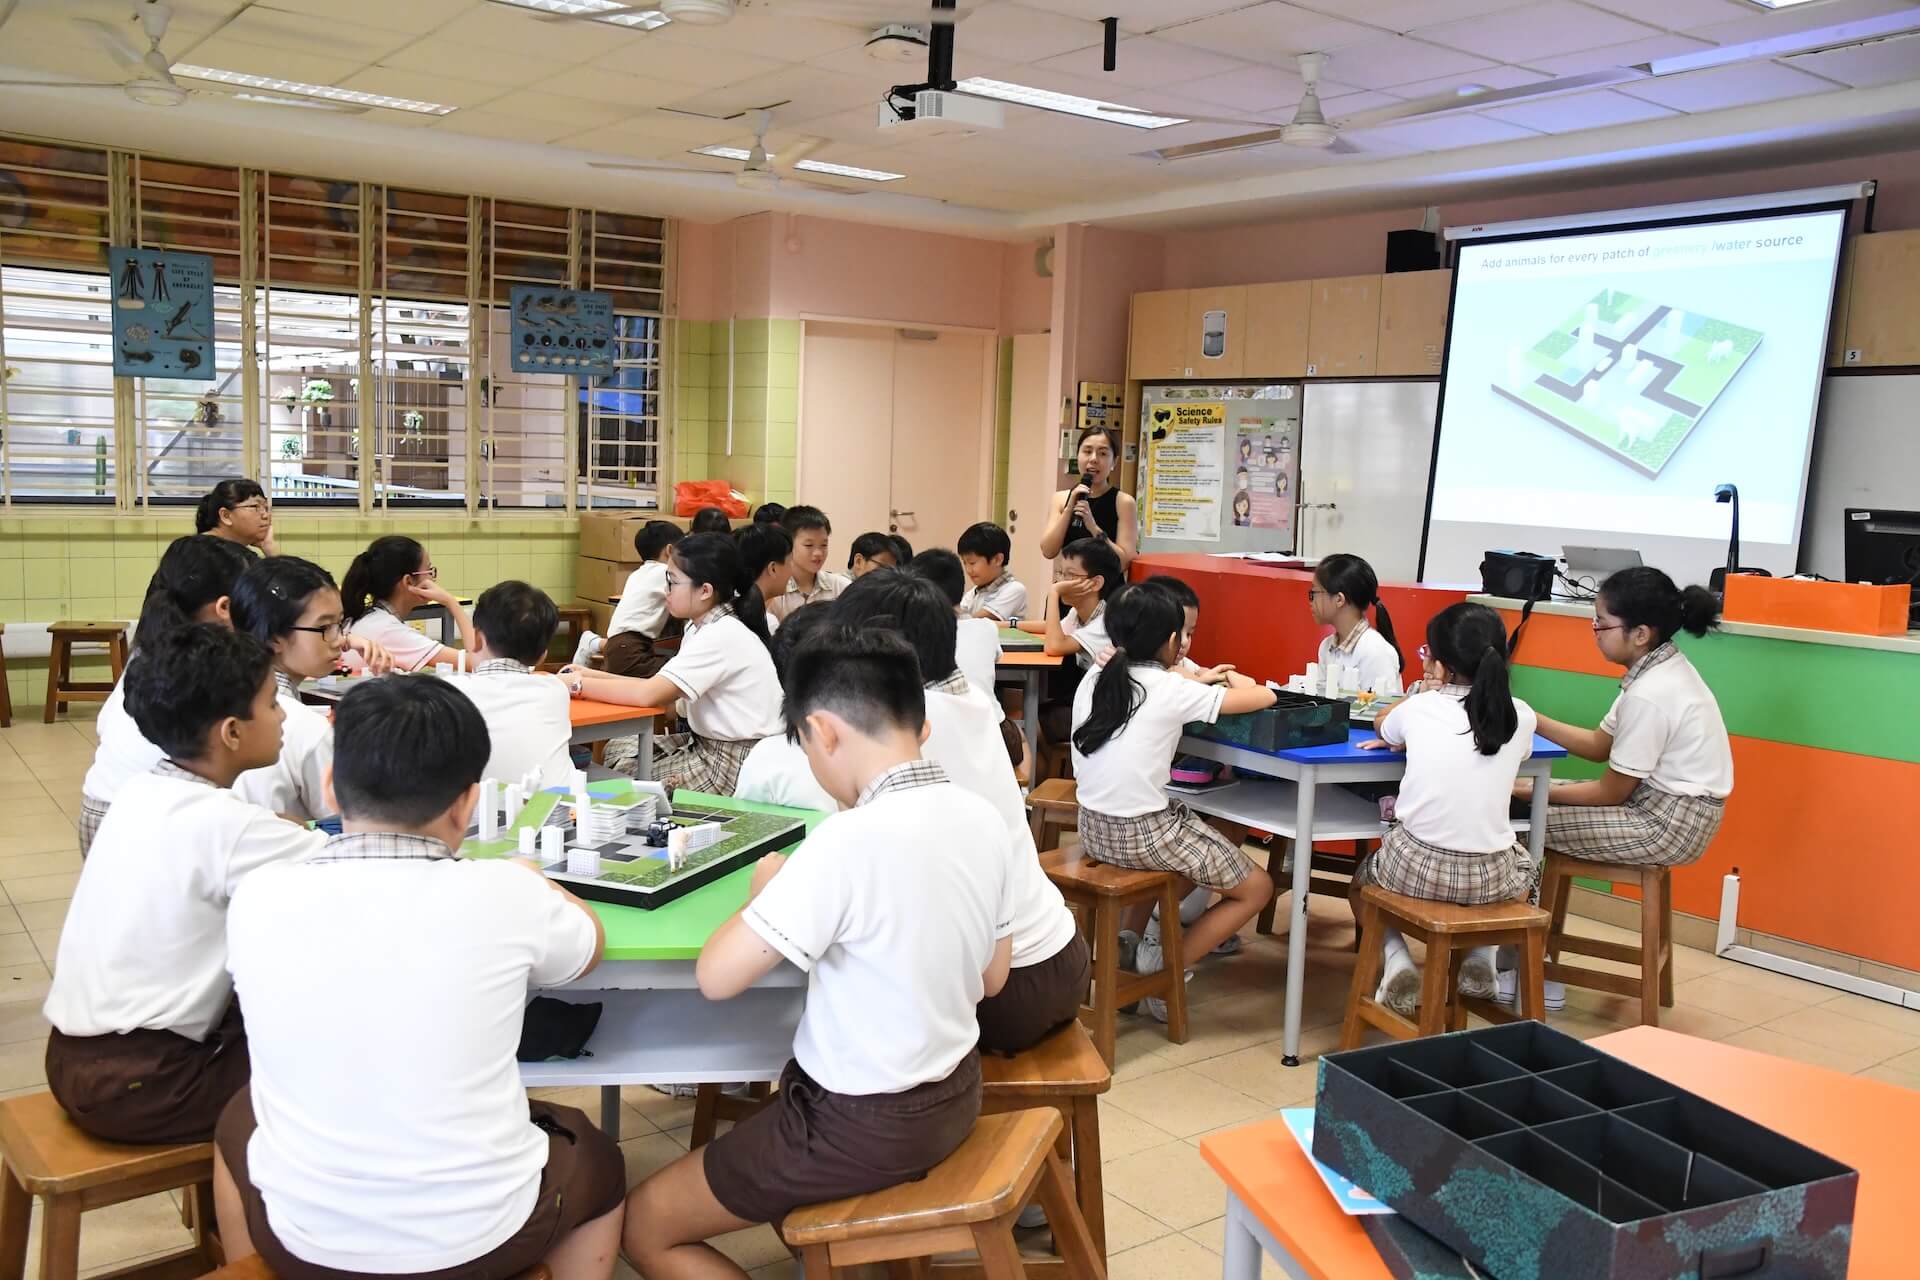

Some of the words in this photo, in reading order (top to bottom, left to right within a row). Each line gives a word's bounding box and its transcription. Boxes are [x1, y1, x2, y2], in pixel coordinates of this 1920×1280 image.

[1481, 258, 1502, 269] Add
[1505, 255, 1546, 267] animals
[1550, 253, 1565, 264] for
[1568, 251, 1599, 263] every
[1602, 247, 1635, 261] patch
[1638, 245, 1651, 257] of
[1711, 239, 1752, 251] /water
[1755, 235, 1804, 248] source
[1176, 407, 1213, 416] Science
[1178, 416, 1201, 426] Safety
[1202, 416, 1223, 424] Rules
